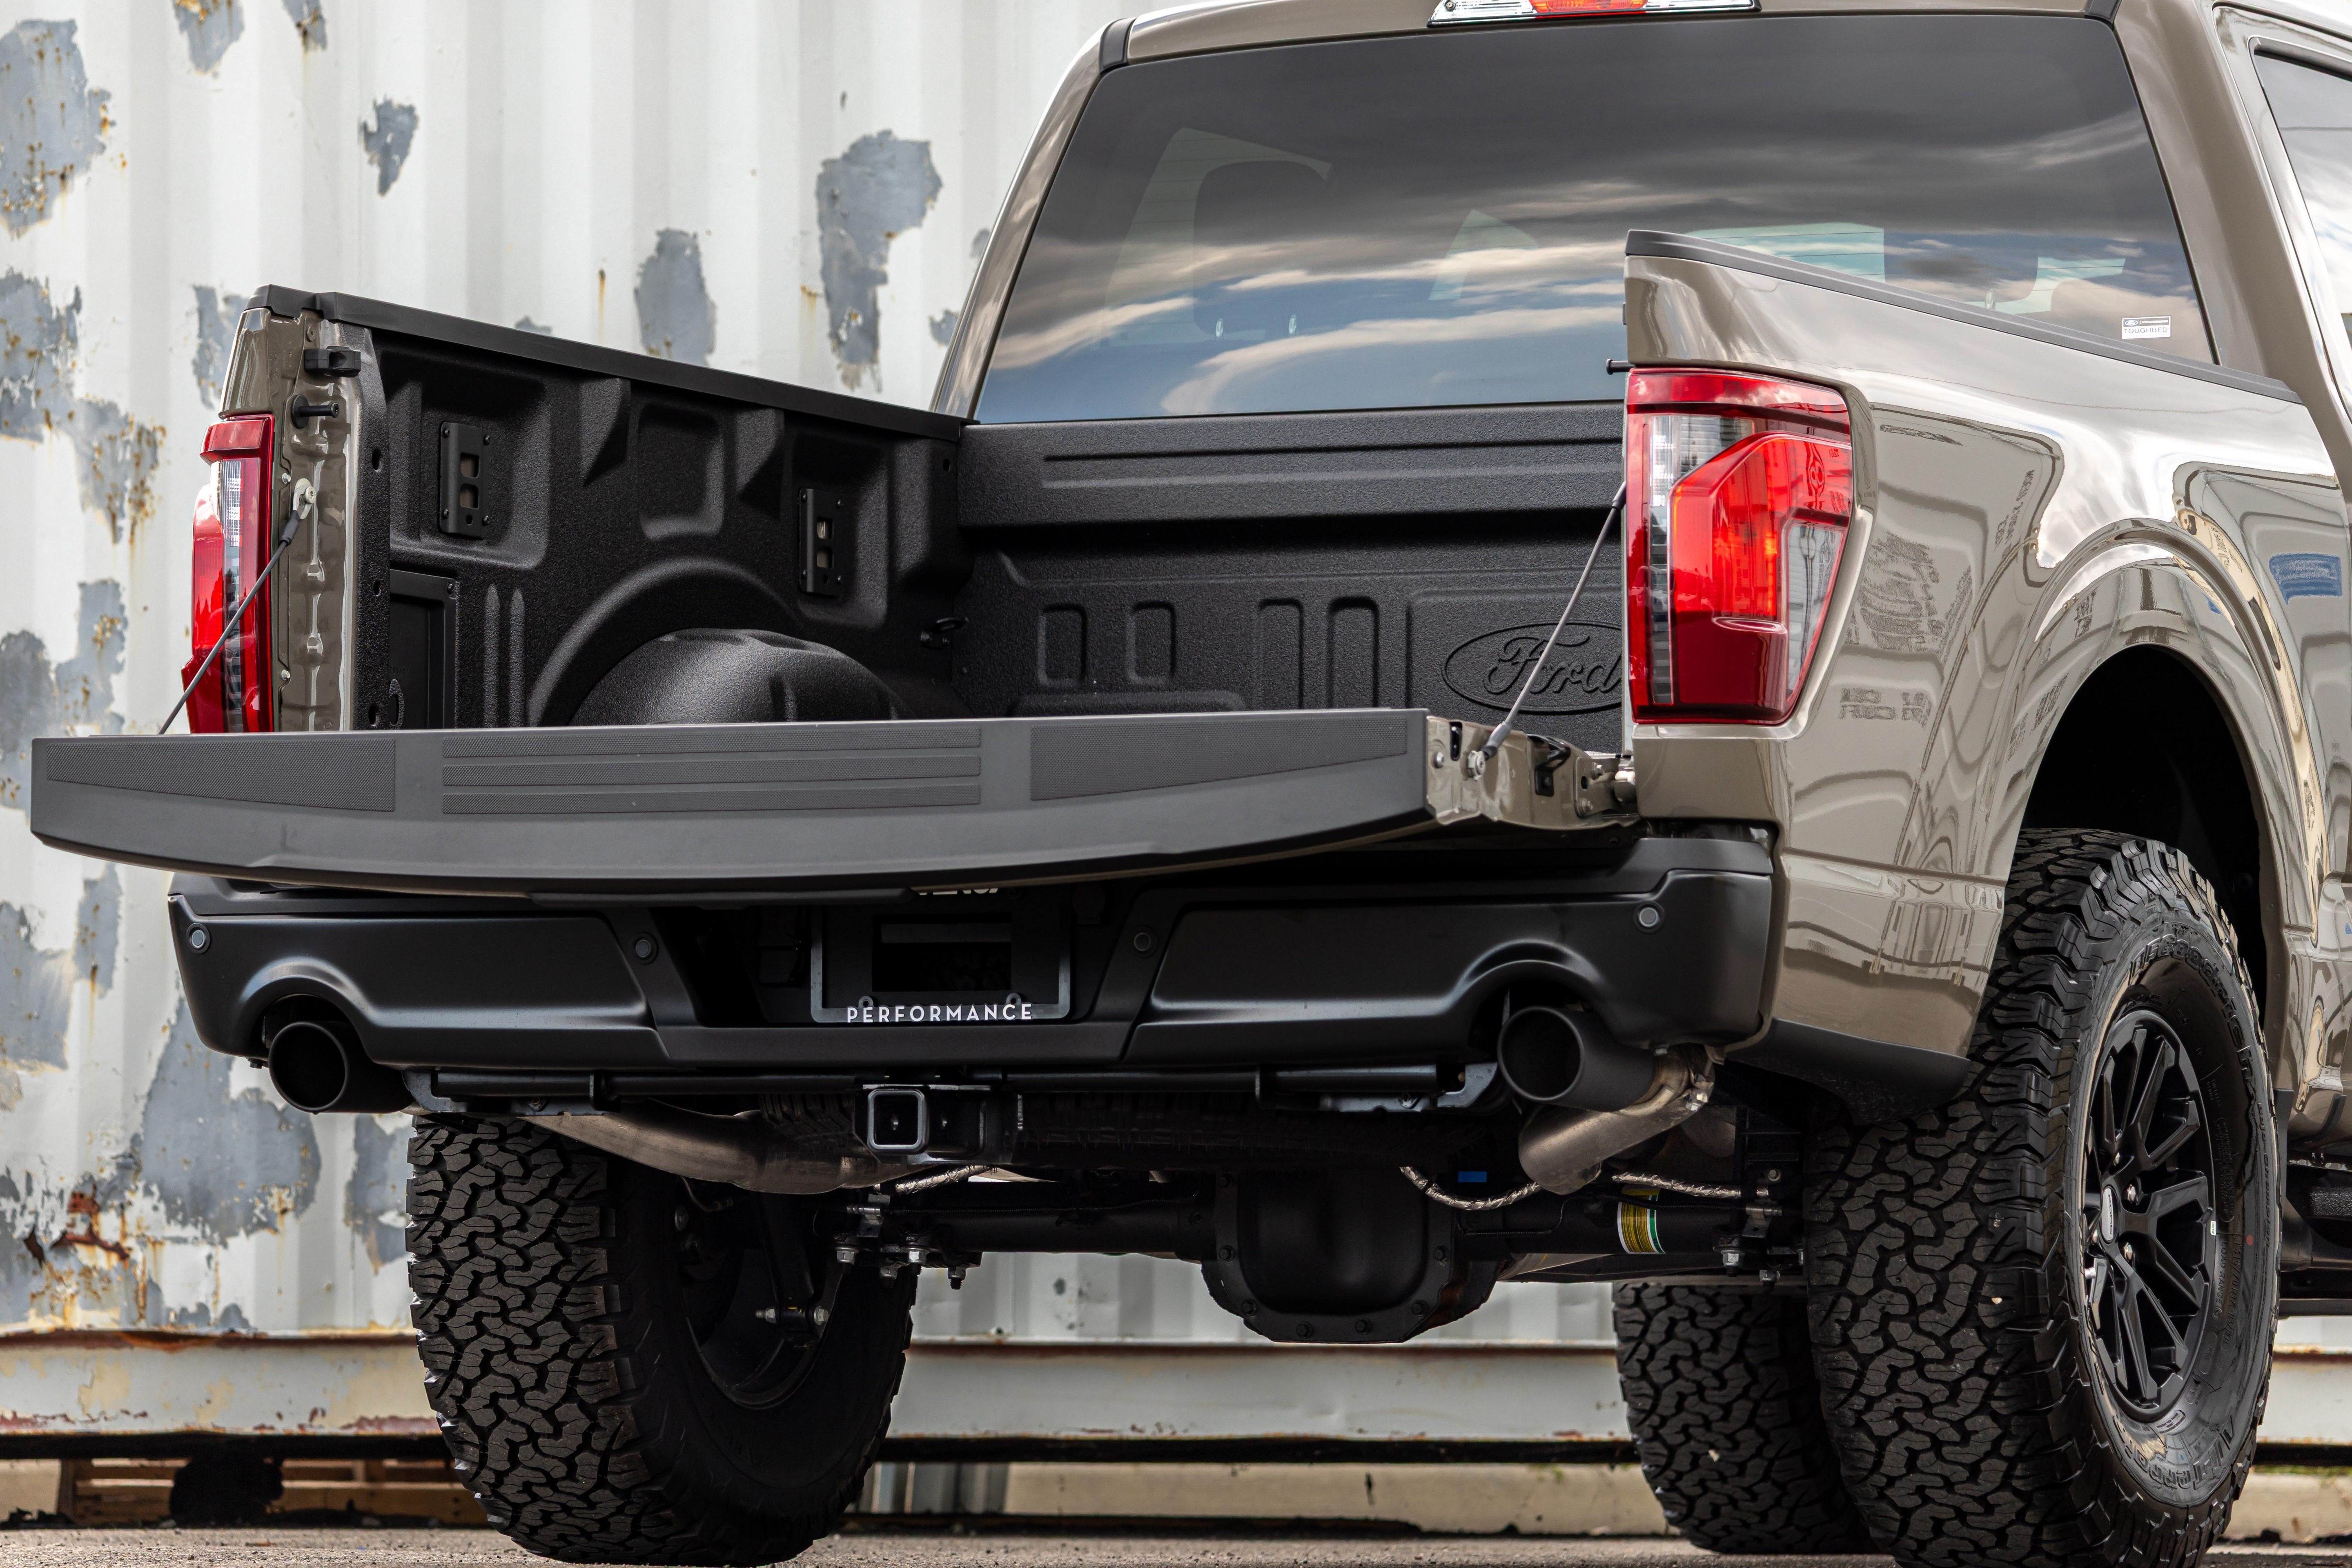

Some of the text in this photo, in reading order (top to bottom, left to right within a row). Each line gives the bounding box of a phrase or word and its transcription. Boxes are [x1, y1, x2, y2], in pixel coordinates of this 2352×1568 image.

[1483, 635, 1621, 695] Ford
[846, 1003, 1032, 1023] PERFORMANCE
[2216, 1271, 2225, 1305] RANGE
